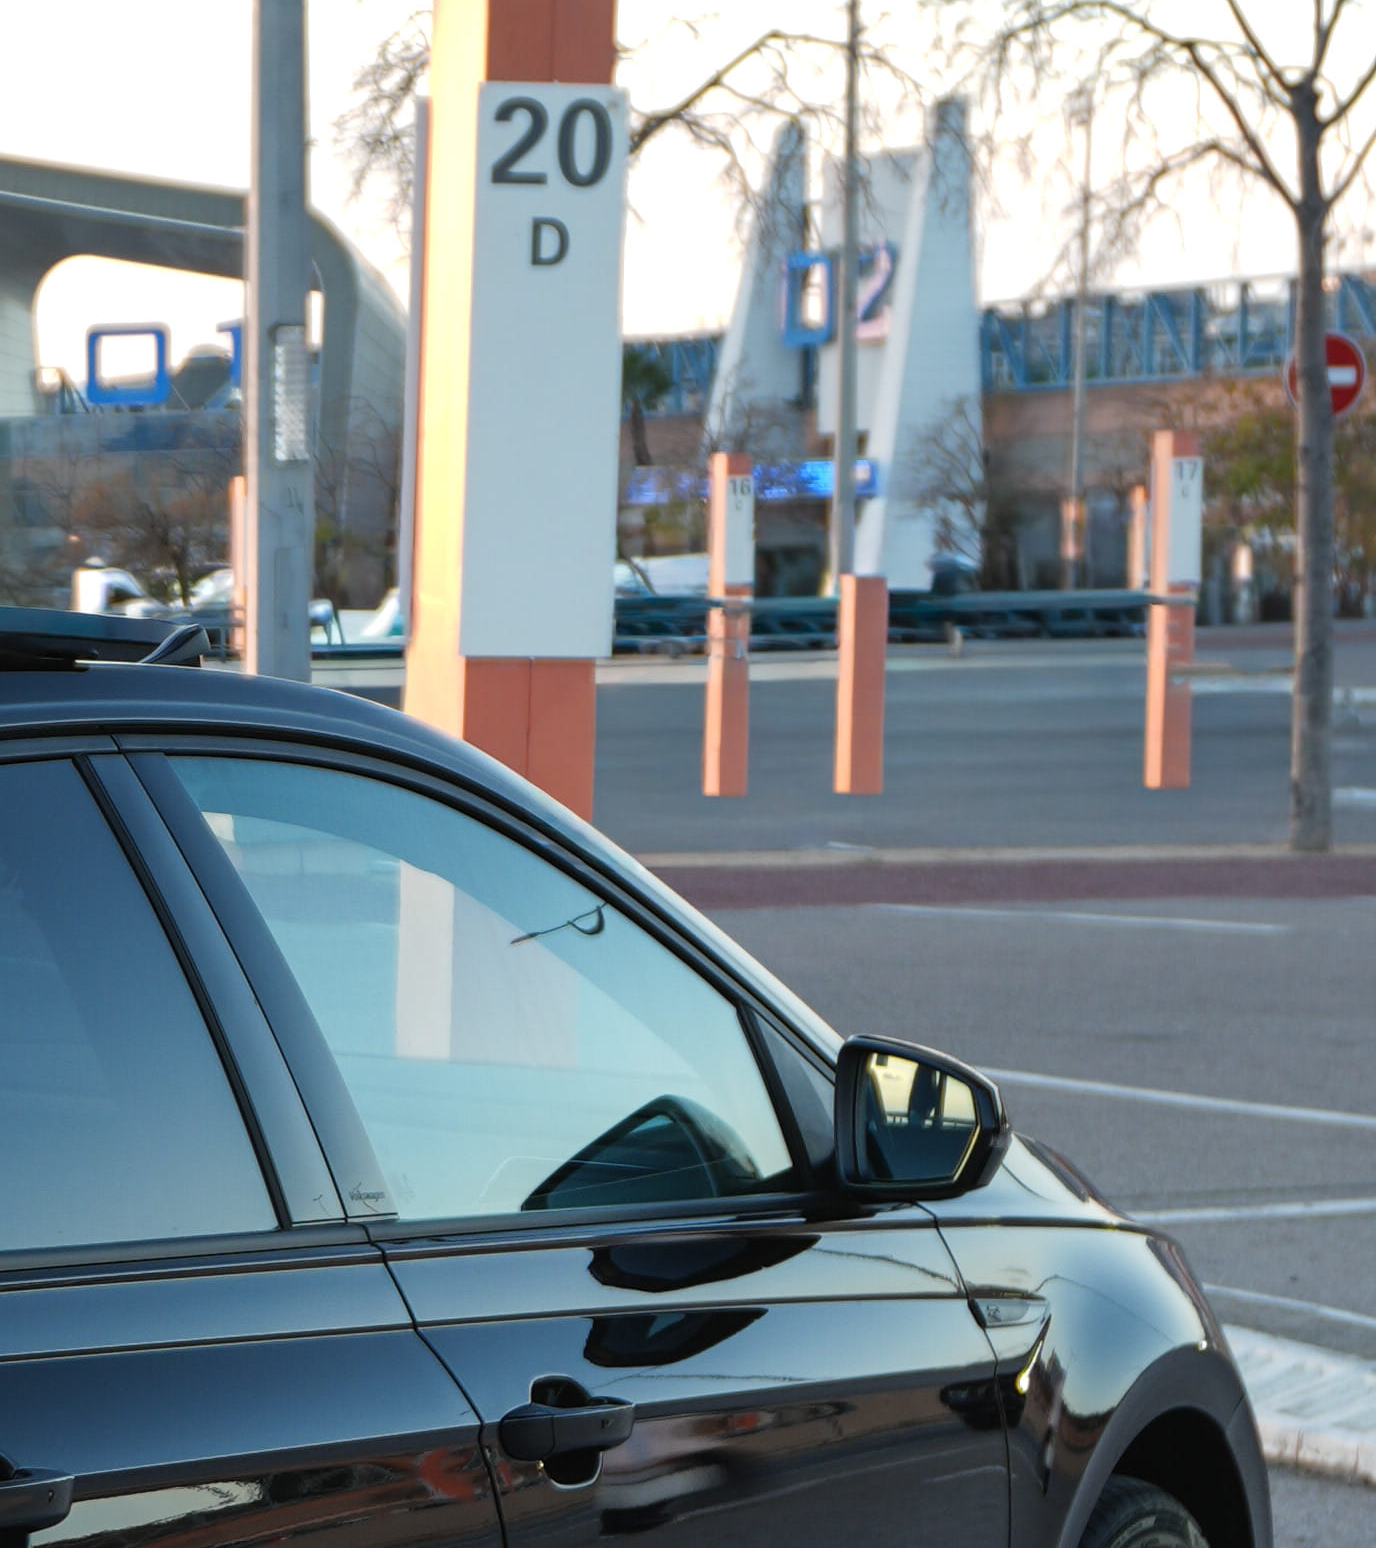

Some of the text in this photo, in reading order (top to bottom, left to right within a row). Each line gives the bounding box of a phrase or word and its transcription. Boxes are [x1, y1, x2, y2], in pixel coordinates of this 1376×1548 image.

[491, 96, 613, 187] 20
[531, 217, 570, 266] D
[729, 478, 751, 496] 16
[1174, 460, 1200, 481] 17
